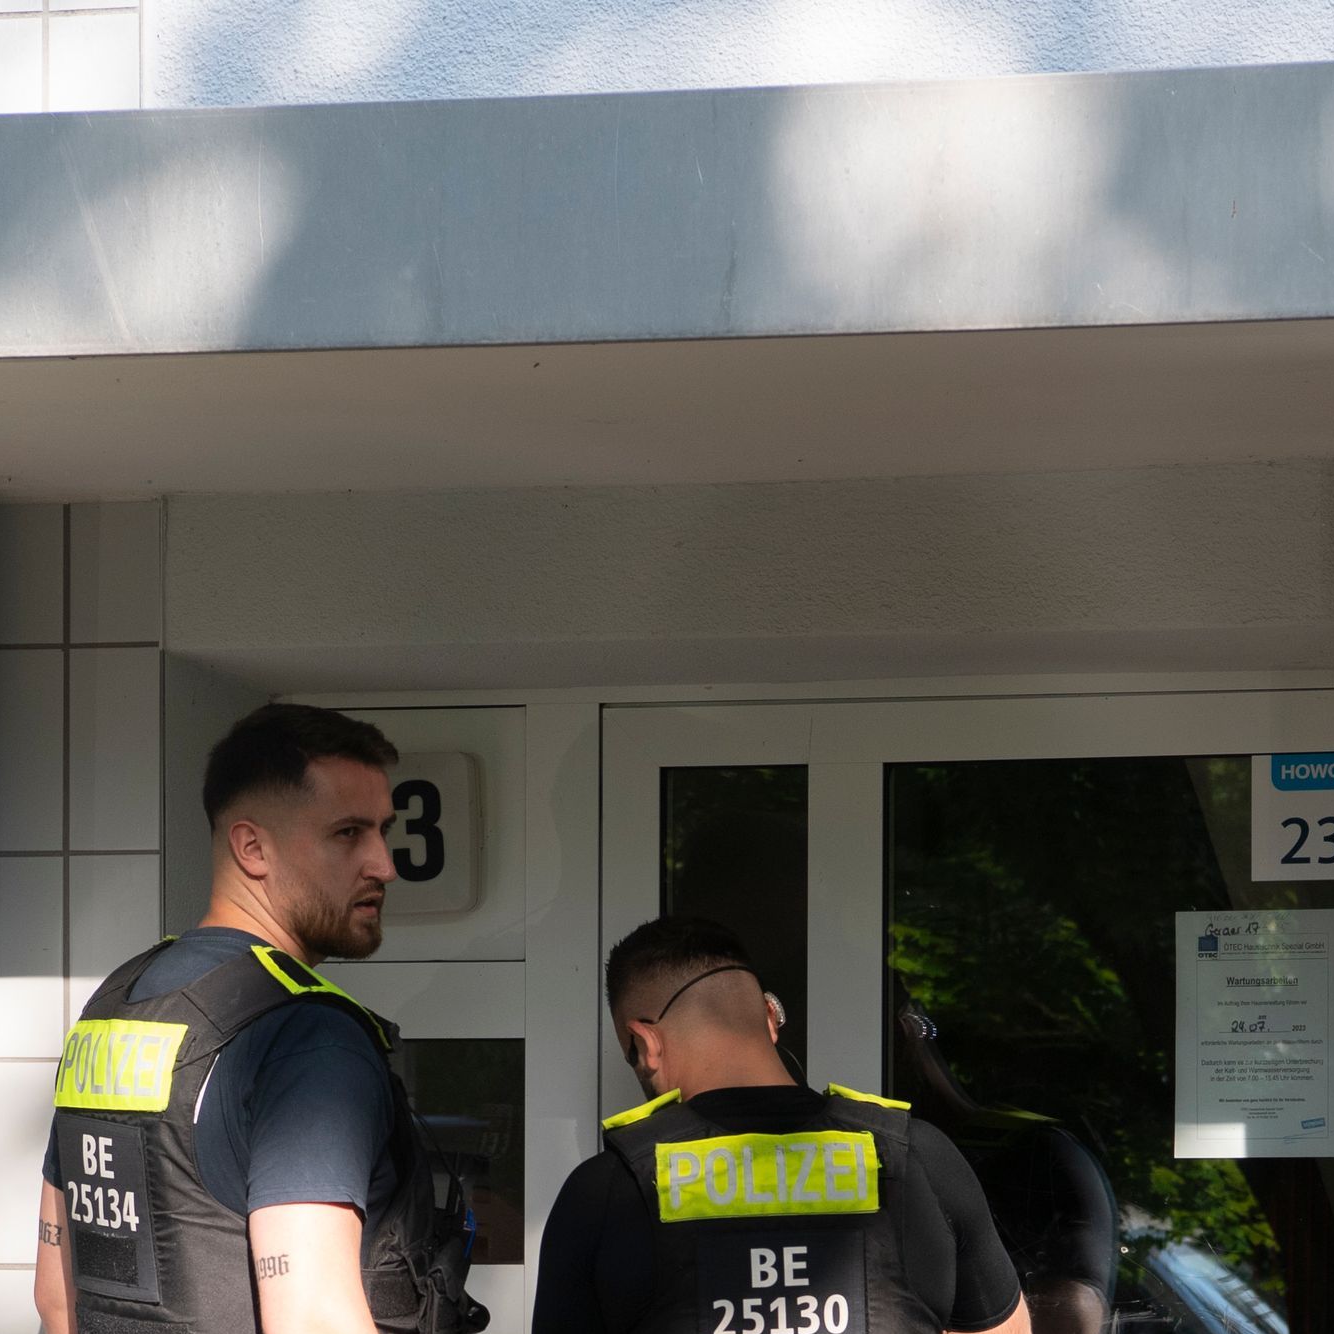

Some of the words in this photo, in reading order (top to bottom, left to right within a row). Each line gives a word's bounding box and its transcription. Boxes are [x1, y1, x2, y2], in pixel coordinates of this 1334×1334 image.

[392, 779, 445, 882] 3
[1305, 941, 1326, 951] GmbH
[1226, 977, 1300, 987] Wartungsarbeiten
[59, 1030, 173, 1098] POLIZEI
[82, 1133, 115, 1180] BE
[668, 1143, 868, 1210] POLIZEI
[67, 1180, 140, 1233] 25134
[749, 1245, 811, 1289] BE
